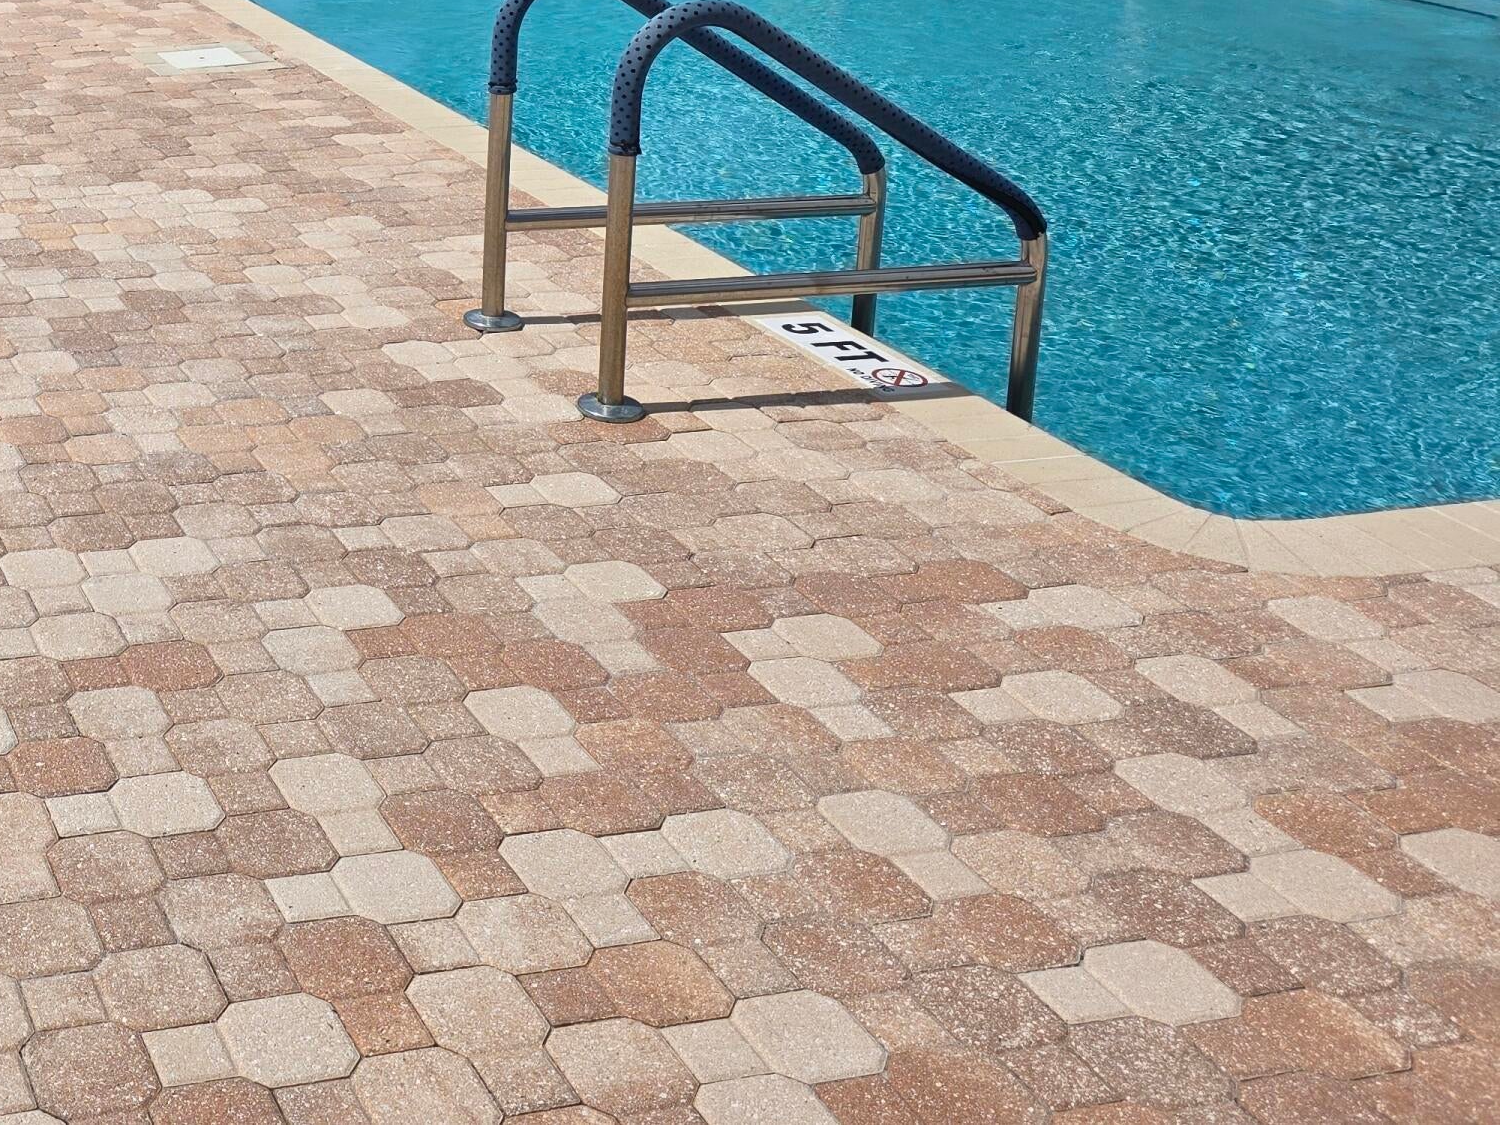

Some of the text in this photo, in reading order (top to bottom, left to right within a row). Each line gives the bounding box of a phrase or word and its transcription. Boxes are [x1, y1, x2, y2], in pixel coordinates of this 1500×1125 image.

[781, 322, 890, 363] 5 FT
[846, 367, 895, 393] NO DIVING
